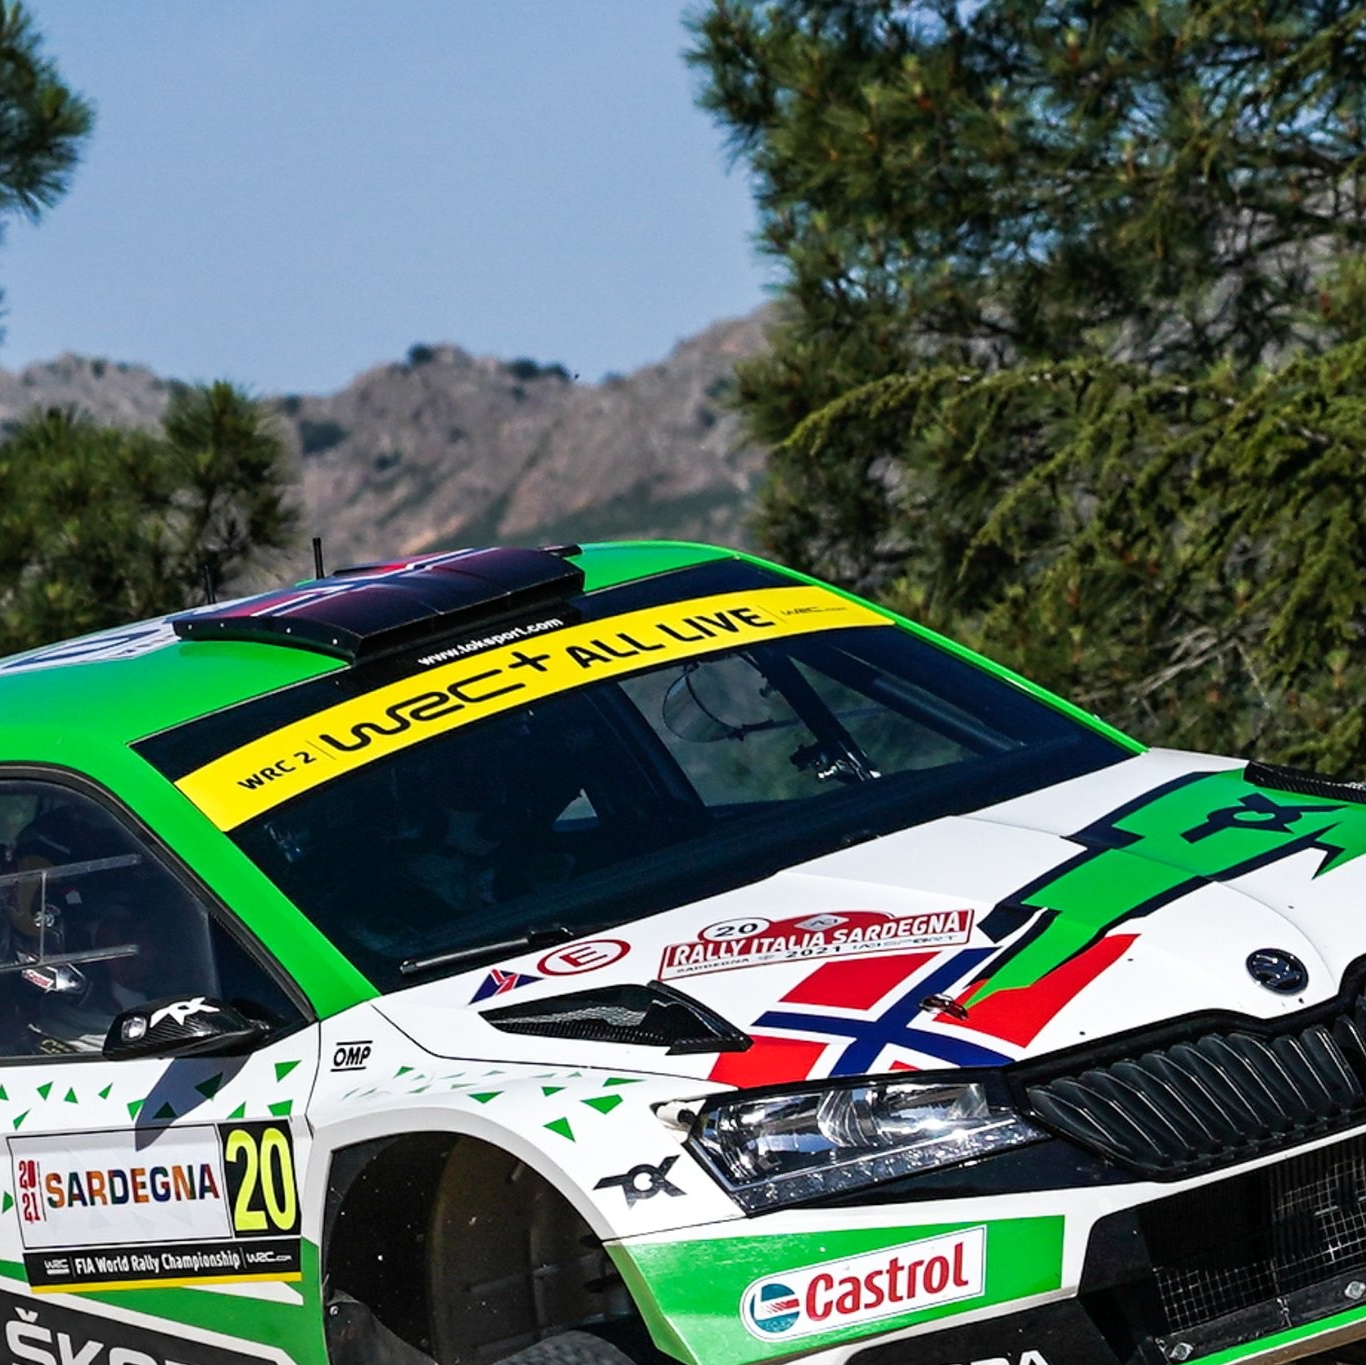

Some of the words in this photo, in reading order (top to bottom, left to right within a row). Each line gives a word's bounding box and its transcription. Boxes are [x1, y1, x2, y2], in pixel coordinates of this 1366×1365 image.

[418, 618, 564, 666] www.toksport.com
[237, 760, 296, 790] WRC
[294, 750, 316, 764] 2
[565, 632, 666, 669] ALL
[656, 607, 776, 641] LIVE
[672, 939, 745, 966] RALLY
[750, 931, 825, 956] ITALIA
[832, 911, 961, 944] SARDEGNA
[714, 922, 758, 938] 20
[333, 1046, 371, 1067] OMP
[45, 1163, 221, 1209] SARDEGNA
[225, 1127, 297, 1231] 20
[74, 1257, 95, 1275] FIA
[95, 1255, 129, 1273] World
[130, 1254, 160, 1274] Rally
[161, 1250, 240, 1272] Championship
[805, 1242, 968, 1321] Castrol
